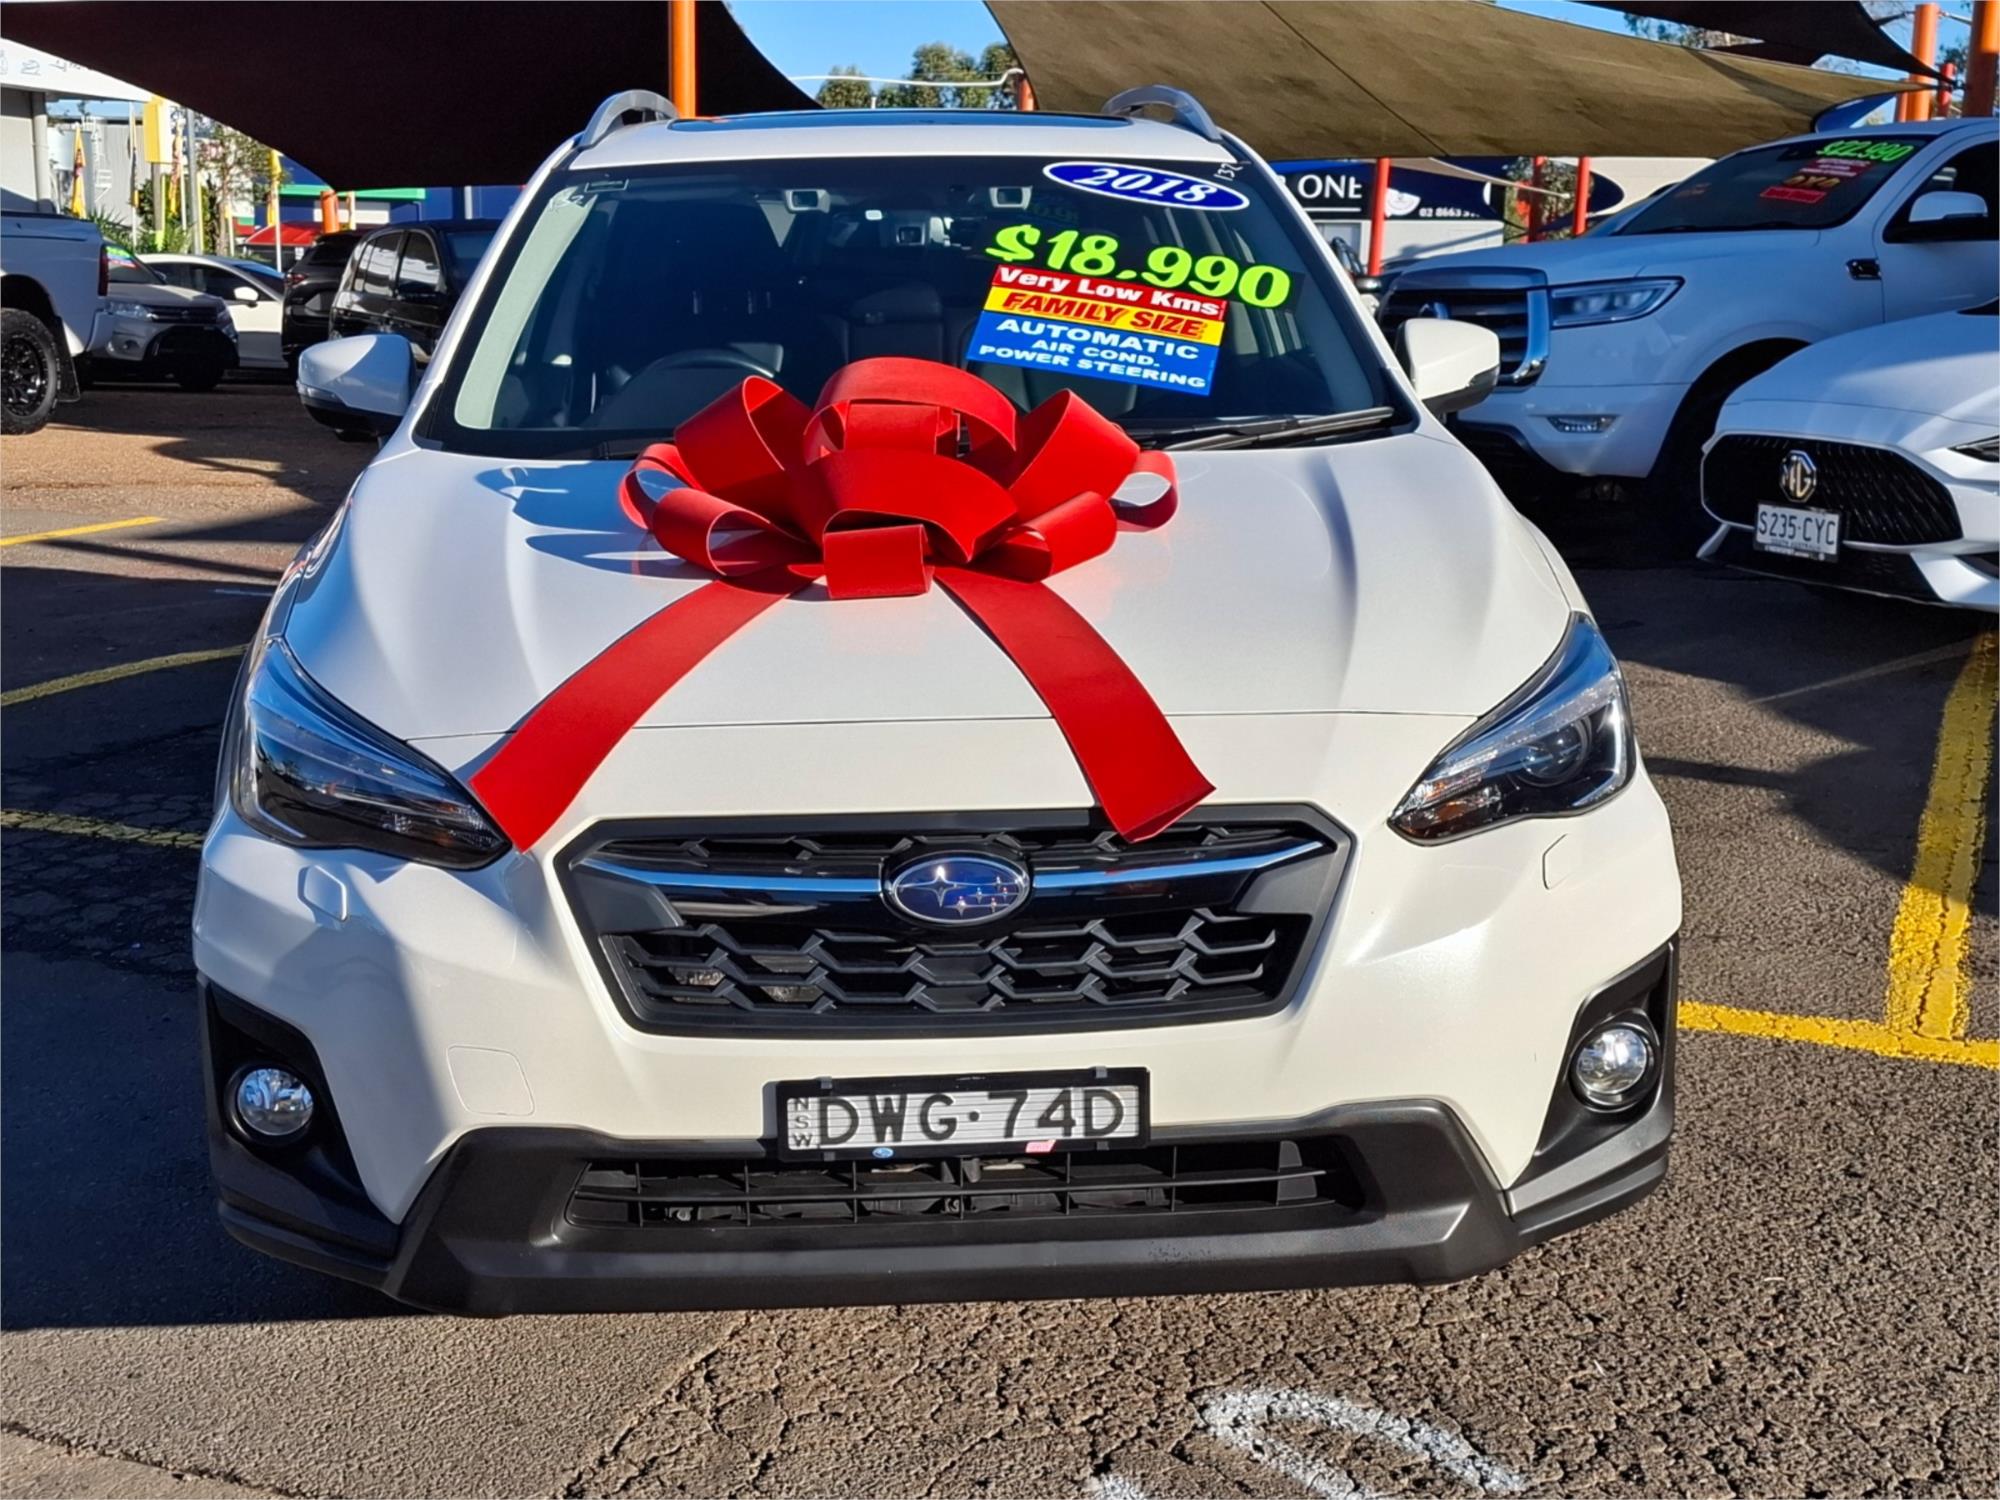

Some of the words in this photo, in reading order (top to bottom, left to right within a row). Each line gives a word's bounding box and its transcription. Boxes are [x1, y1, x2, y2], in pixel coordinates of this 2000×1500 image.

[1073, 167, 1218, 202] 2018
[1298, 174, 1362, 198] ONE
[1000, 267, 1070, 293] Very
[1077, 279, 1143, 302] Low
[1150, 290, 1220, 316] Kms
[1002, 292, 1124, 324] FAMILY
[1129, 311, 1207, 339] SIZE
[996, 319, 1199, 360] AUTOMATIC
[1031, 339, 1077, 354] AIR
[1083, 347, 1160, 367] COND.
[978, 345, 1070, 367] POWER
[1076, 359, 1206, 388] STEERING
